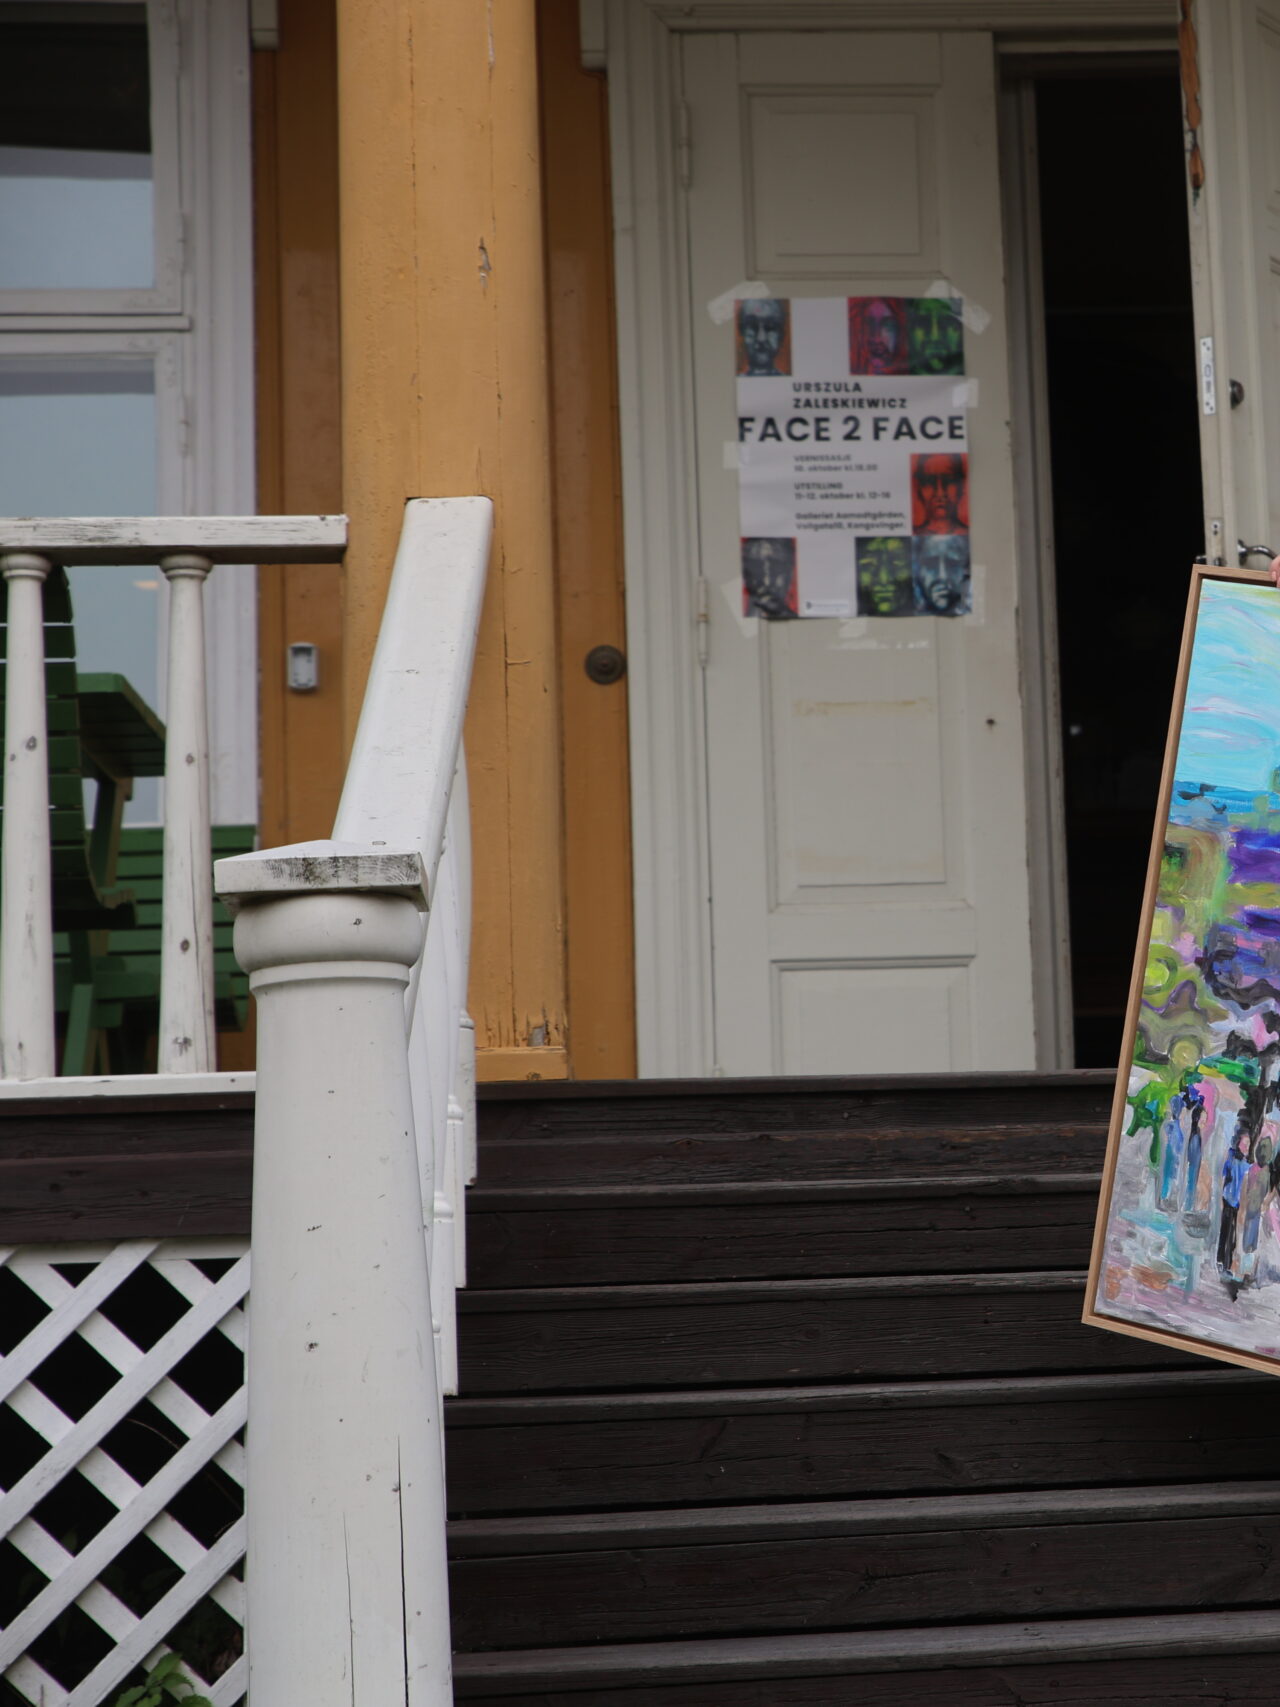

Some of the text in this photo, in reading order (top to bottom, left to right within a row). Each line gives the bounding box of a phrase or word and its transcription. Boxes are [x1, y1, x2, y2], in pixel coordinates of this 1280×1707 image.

[793, 382, 862, 392] URSZULA
[794, 398, 907, 408] ZALESKIEWICZ
[738, 415, 965, 442] FACE 2 FACE
